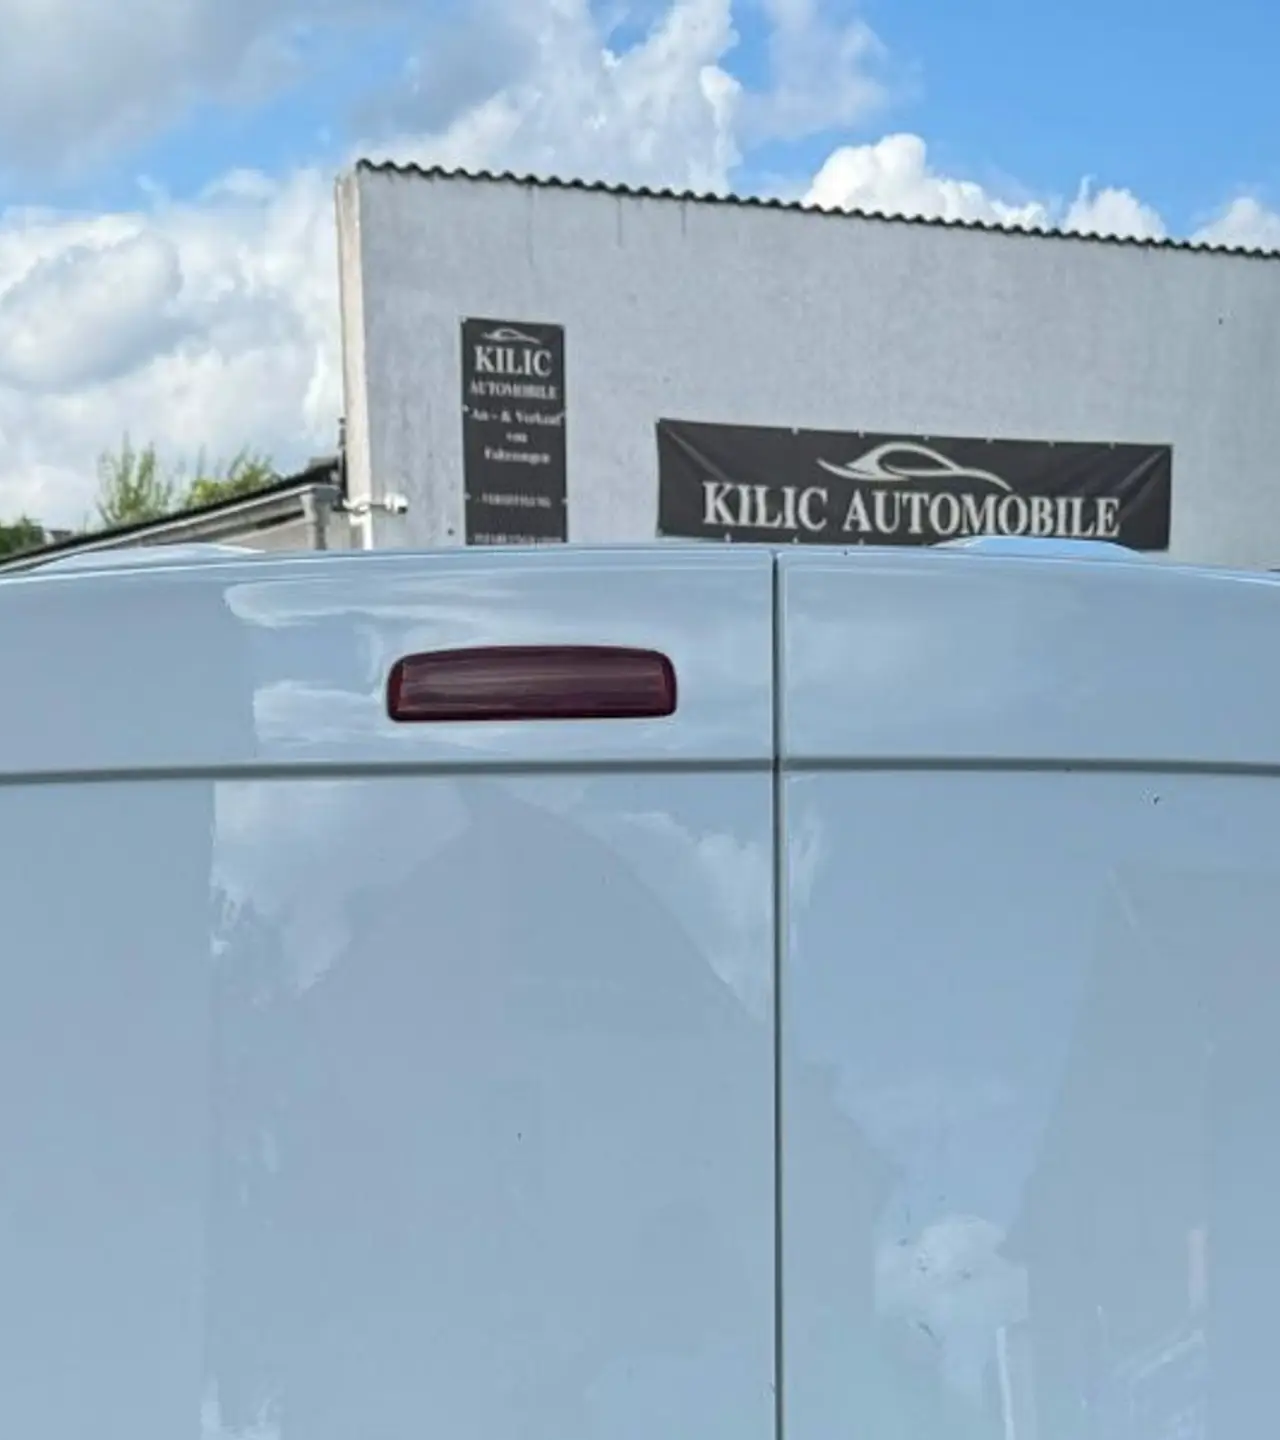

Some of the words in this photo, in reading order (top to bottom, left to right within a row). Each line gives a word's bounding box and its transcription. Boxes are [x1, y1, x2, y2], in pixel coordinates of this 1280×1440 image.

[474, 345, 552, 378] KILIC
[469, 379, 557, 400] AUTOMOBILE
[702, 480, 827, 532] KILIC
[842, 488, 1120, 537] AUTOMOBILE
